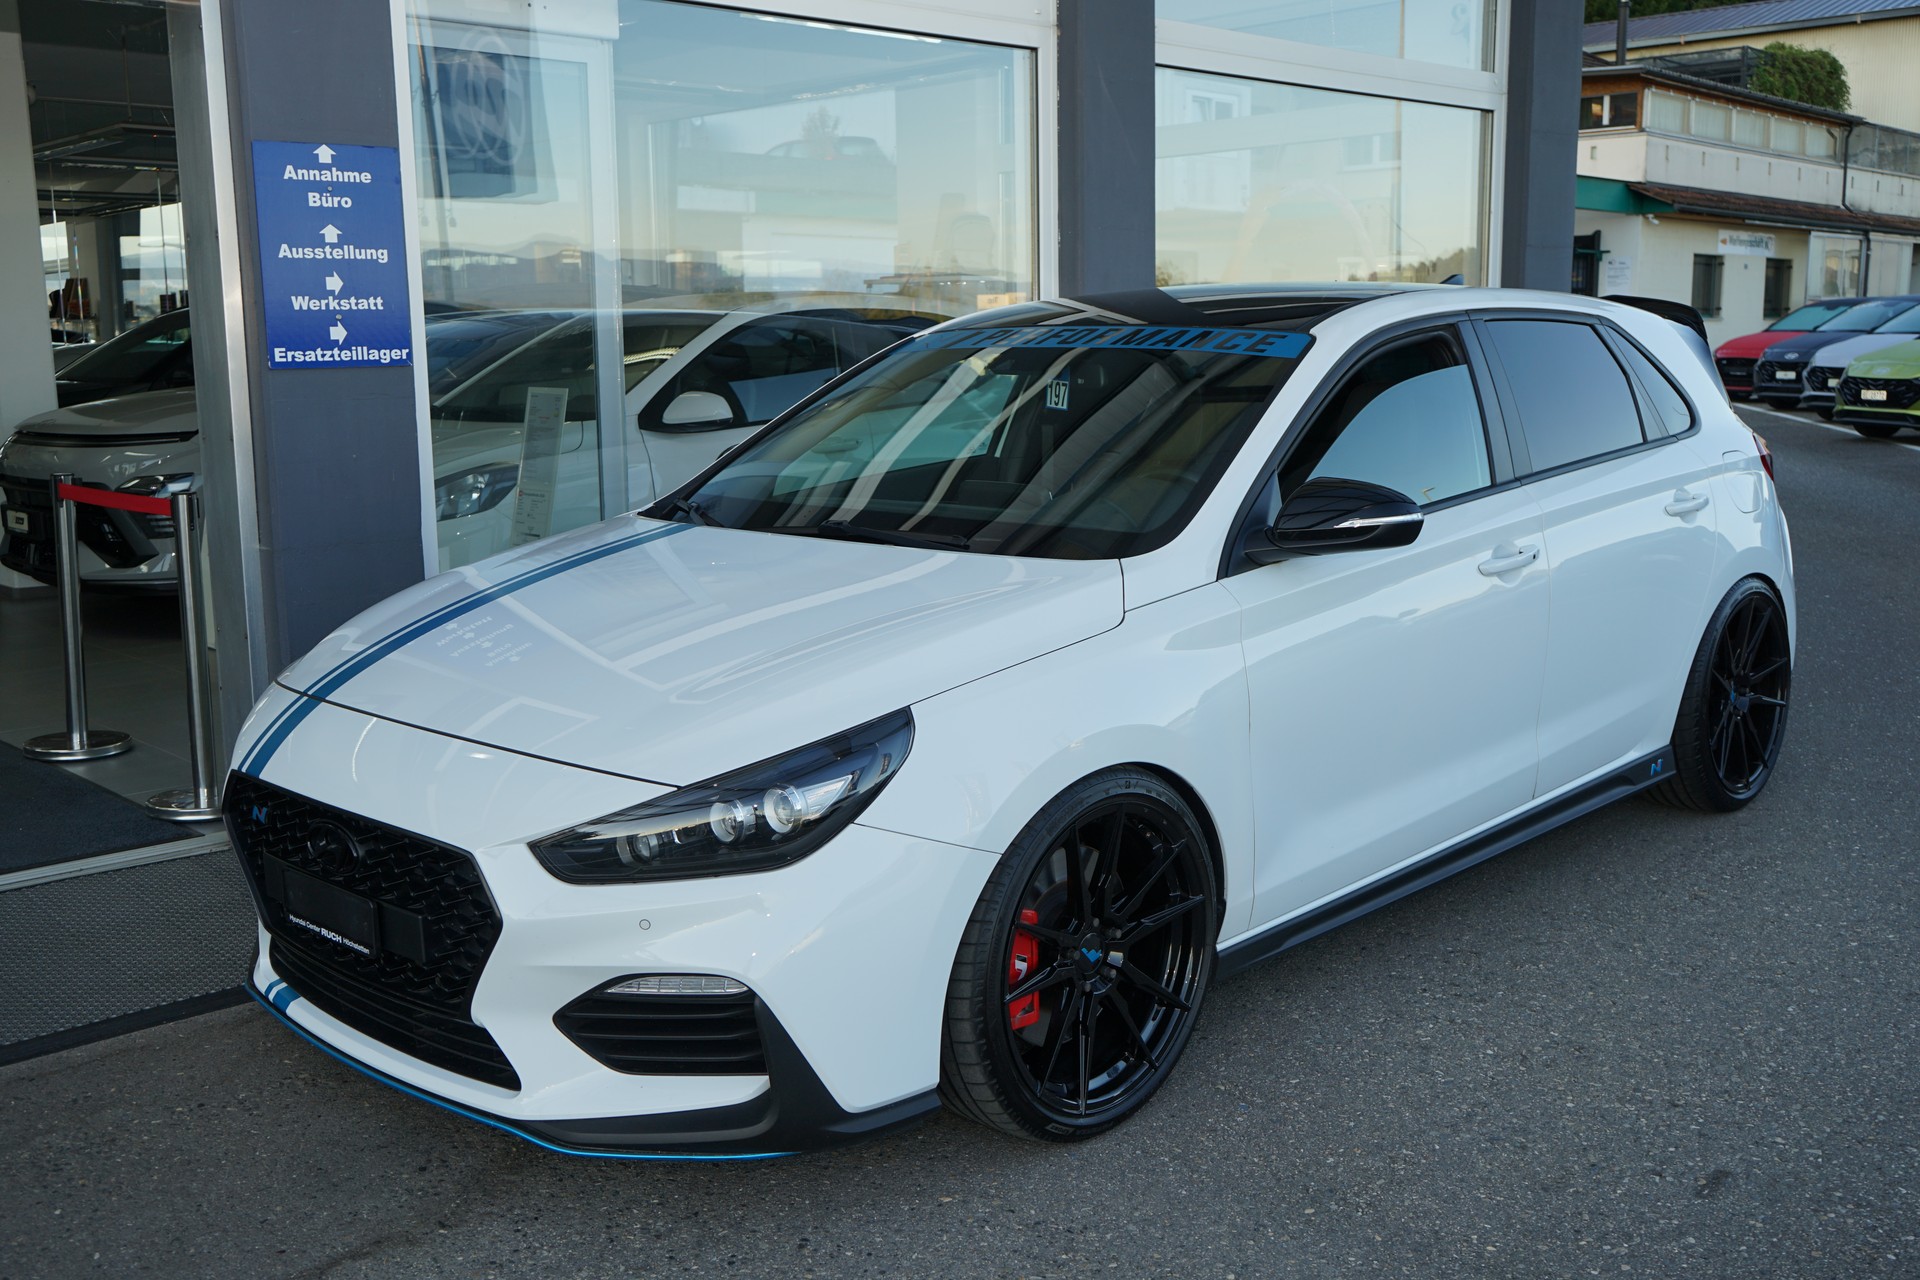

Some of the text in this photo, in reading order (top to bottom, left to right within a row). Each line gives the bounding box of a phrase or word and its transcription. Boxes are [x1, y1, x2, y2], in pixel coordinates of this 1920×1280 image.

[283, 165, 372, 183] Annahme
[308, 192, 352, 208] Büro
[278, 244, 388, 263] Ausstellung
[291, 296, 384, 310] Werkstatt
[971, 328, 1288, 353] PERFORMANCE
[274, 346, 409, 363] Ersatzteillager
[1049, 381, 1067, 407] 197
[1651, 758, 1663, 776] N
[252, 806, 268, 824] N
[289, 913, 306, 927] Hyundai
[306, 921, 321, 933] Center
[321, 928, 342, 943] RUCH
